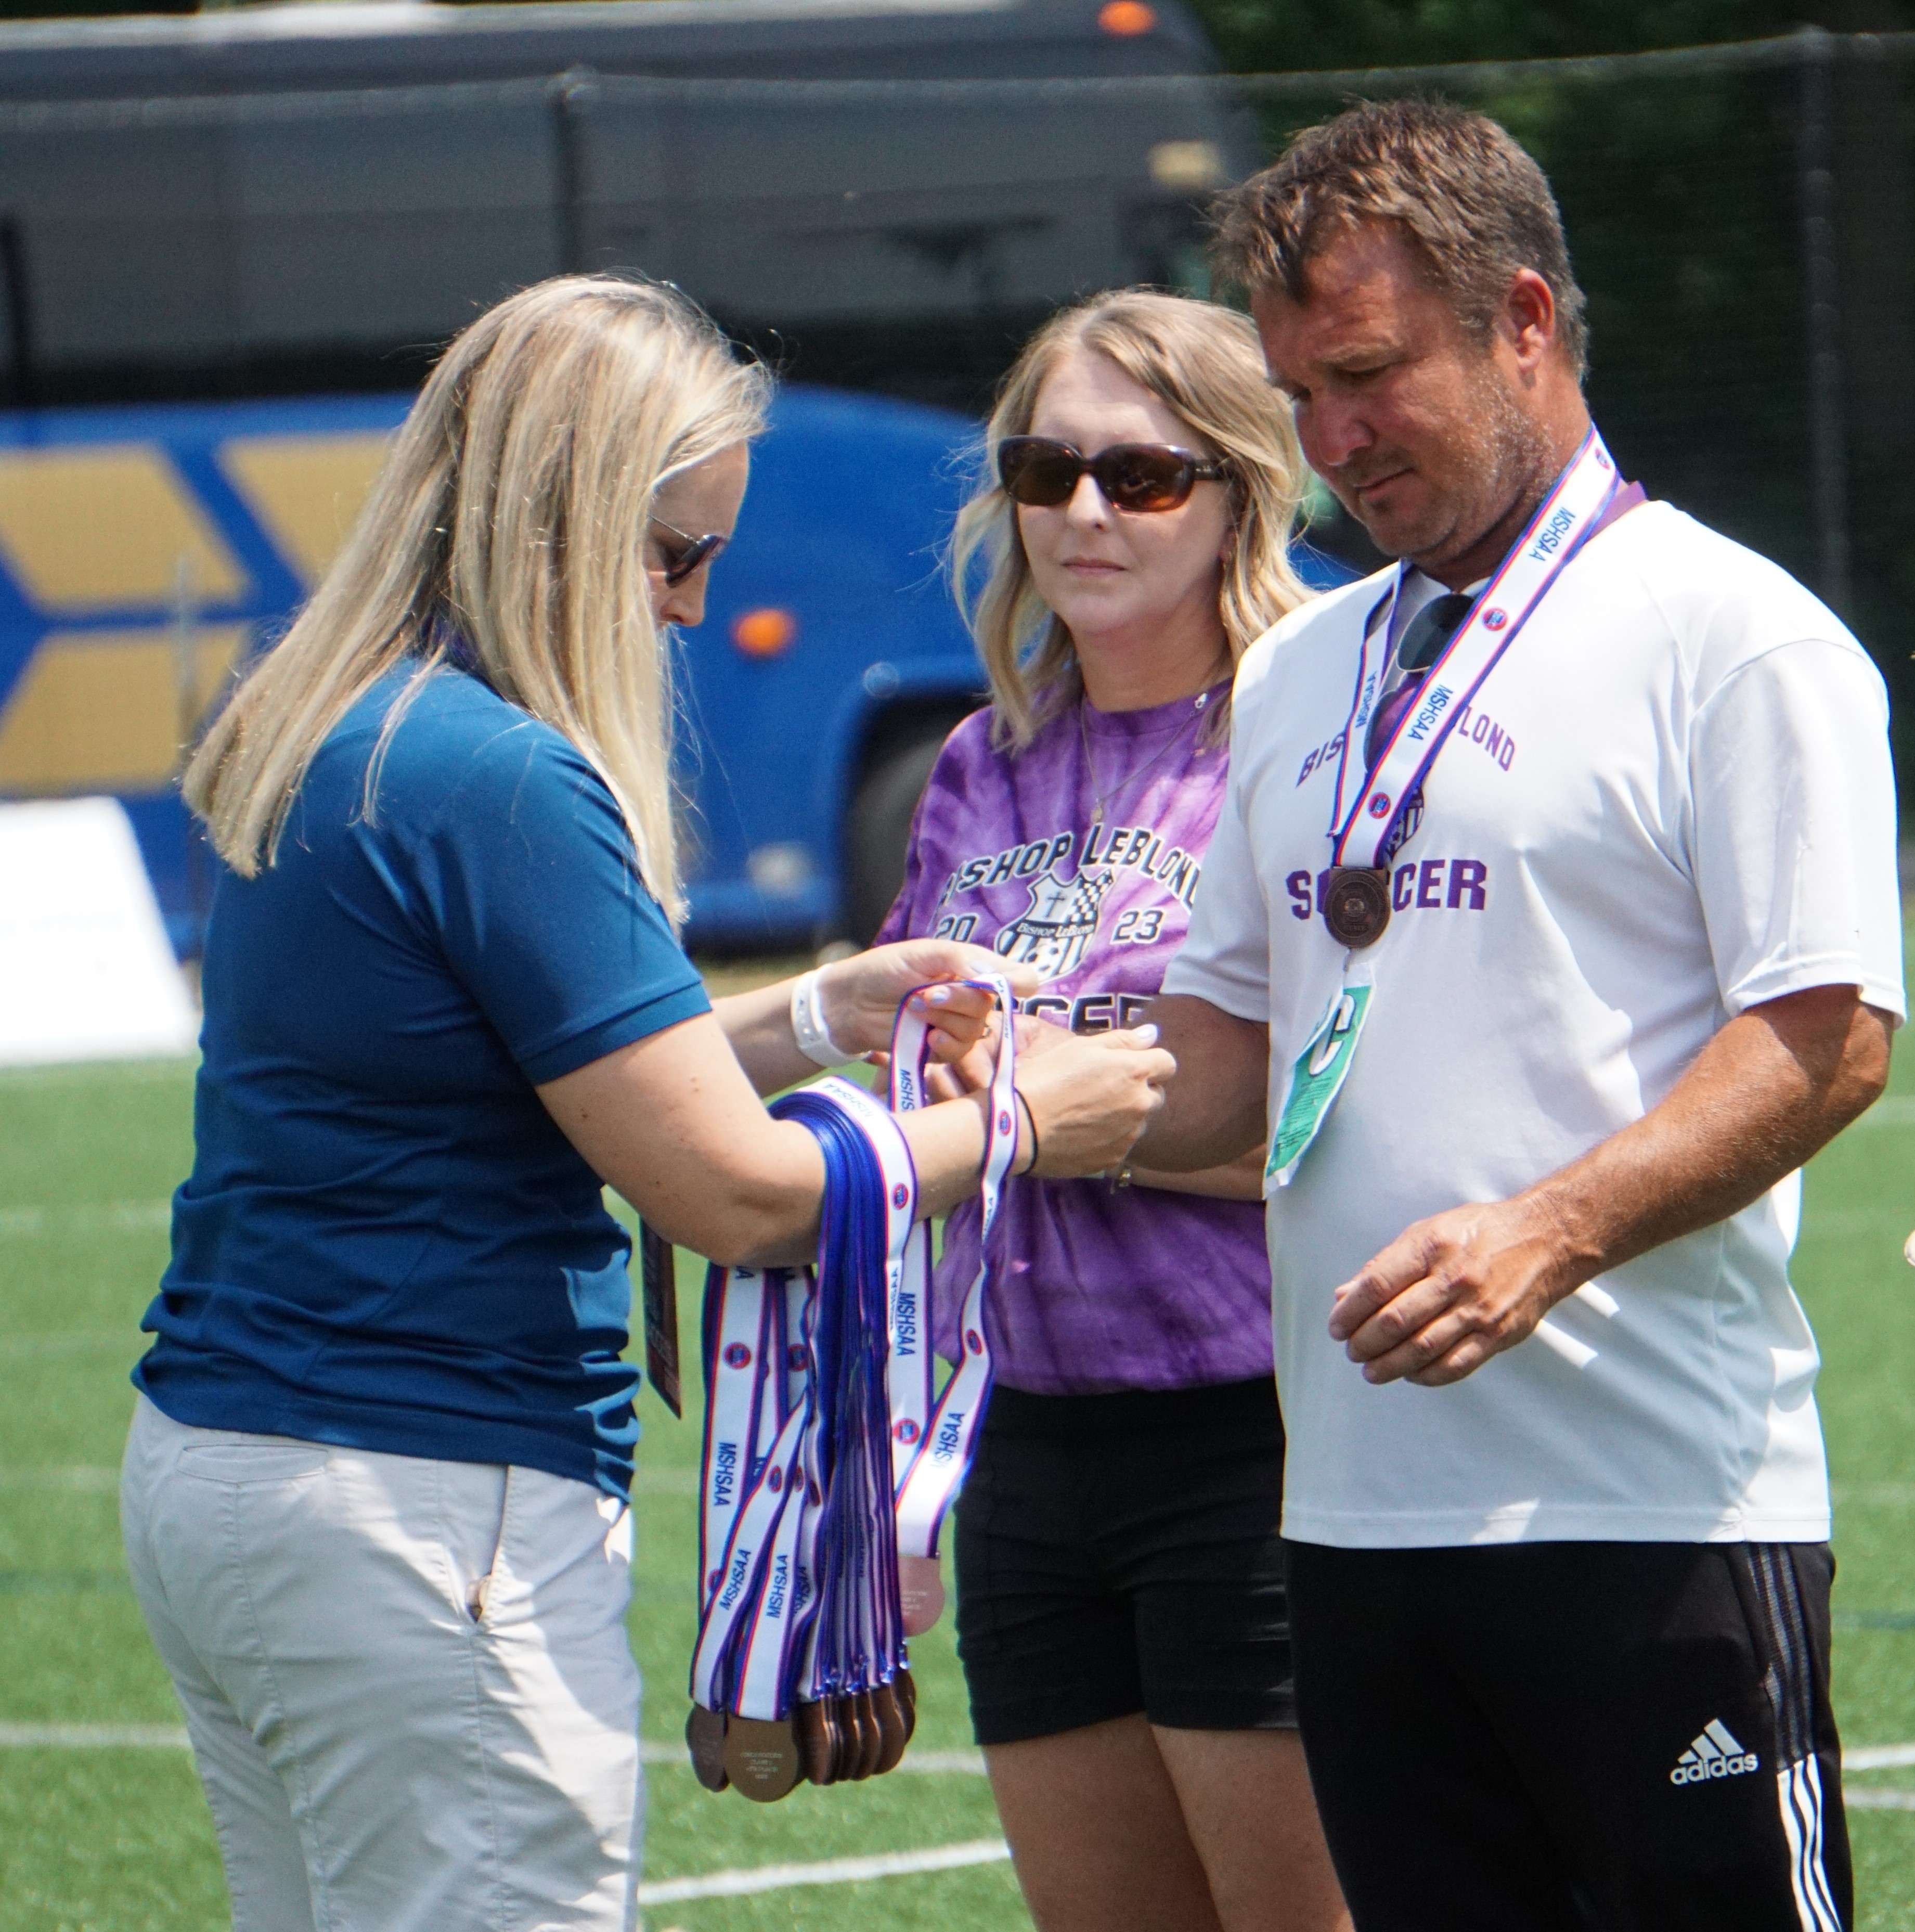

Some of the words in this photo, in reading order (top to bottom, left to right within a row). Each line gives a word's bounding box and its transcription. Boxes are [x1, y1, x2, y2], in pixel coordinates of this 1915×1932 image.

[1528, 507, 1576, 562] MSHSAA
[1406, 684, 1454, 741] MSHSAA
[1109, 907, 1166, 945] 23
[899, 1068, 915, 1111] MSHS
[897, 1292, 916, 1356] MSHSAA
[930, 1412, 965, 1467] MSHSAA
[714, 1442, 737, 1506] MSHSAA
[719, 1549, 752, 1611] MSHSAA
[765, 1554, 788, 1618] MSHSAA
[1670, 1752, 1758, 1785] adidas
